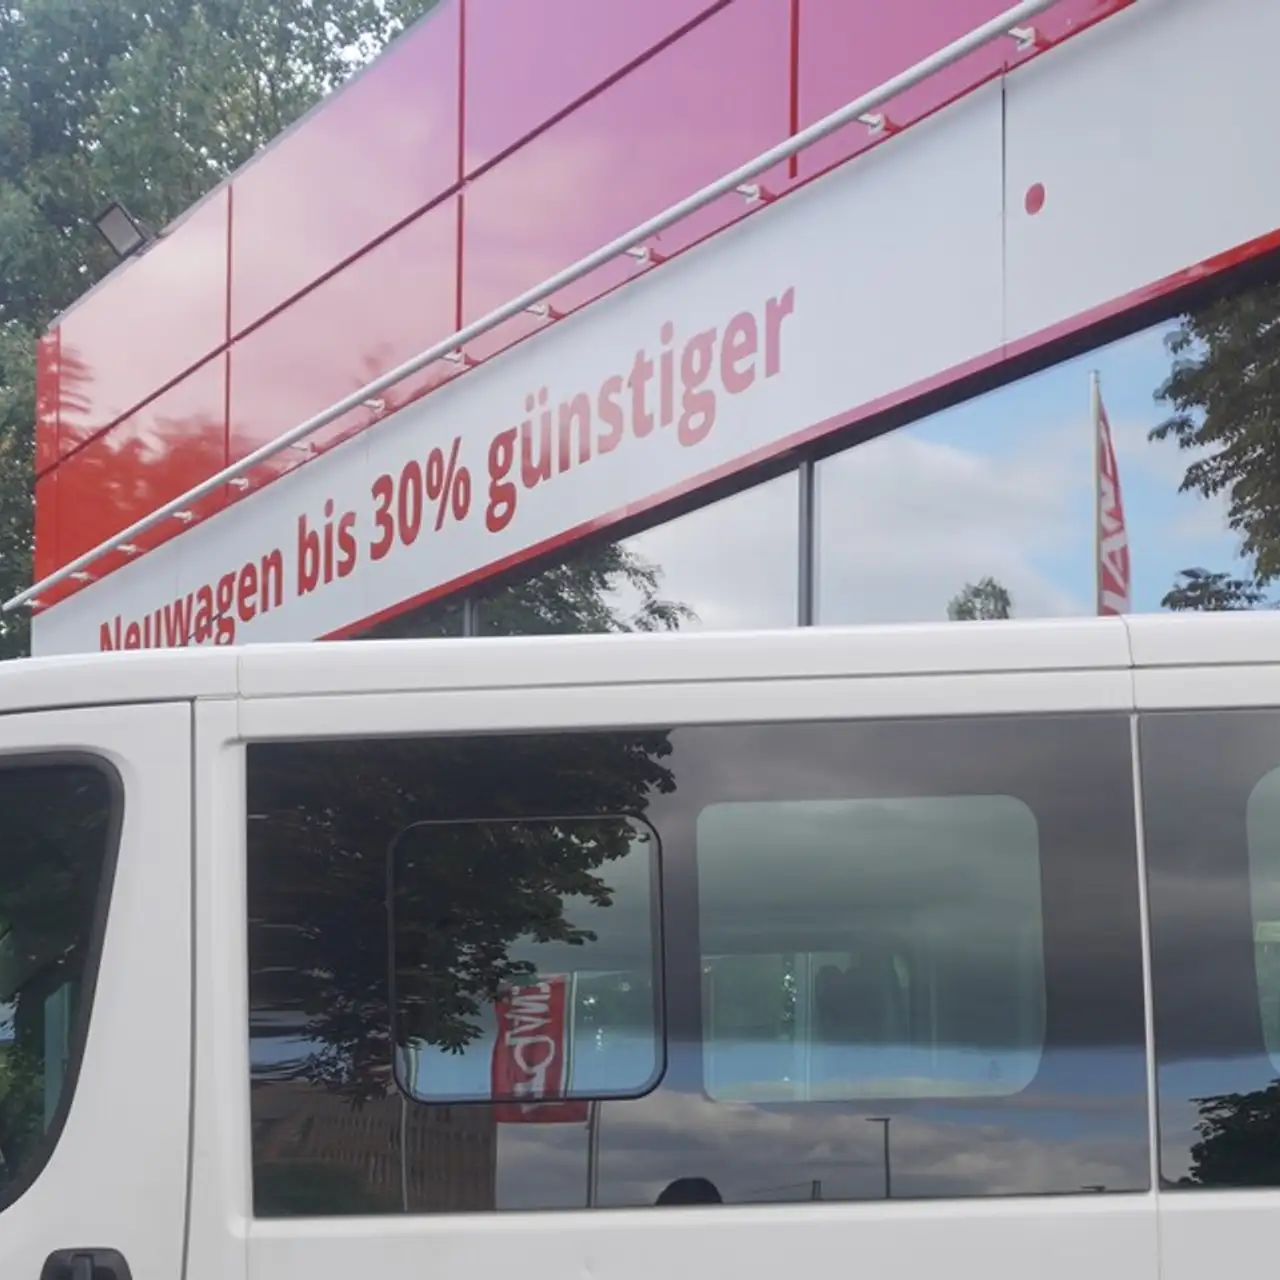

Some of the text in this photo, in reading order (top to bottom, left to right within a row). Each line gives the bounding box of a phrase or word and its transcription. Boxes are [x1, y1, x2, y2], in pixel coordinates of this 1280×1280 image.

[99, 285, 796, 652] Neuwagen bis 30% günstiger
